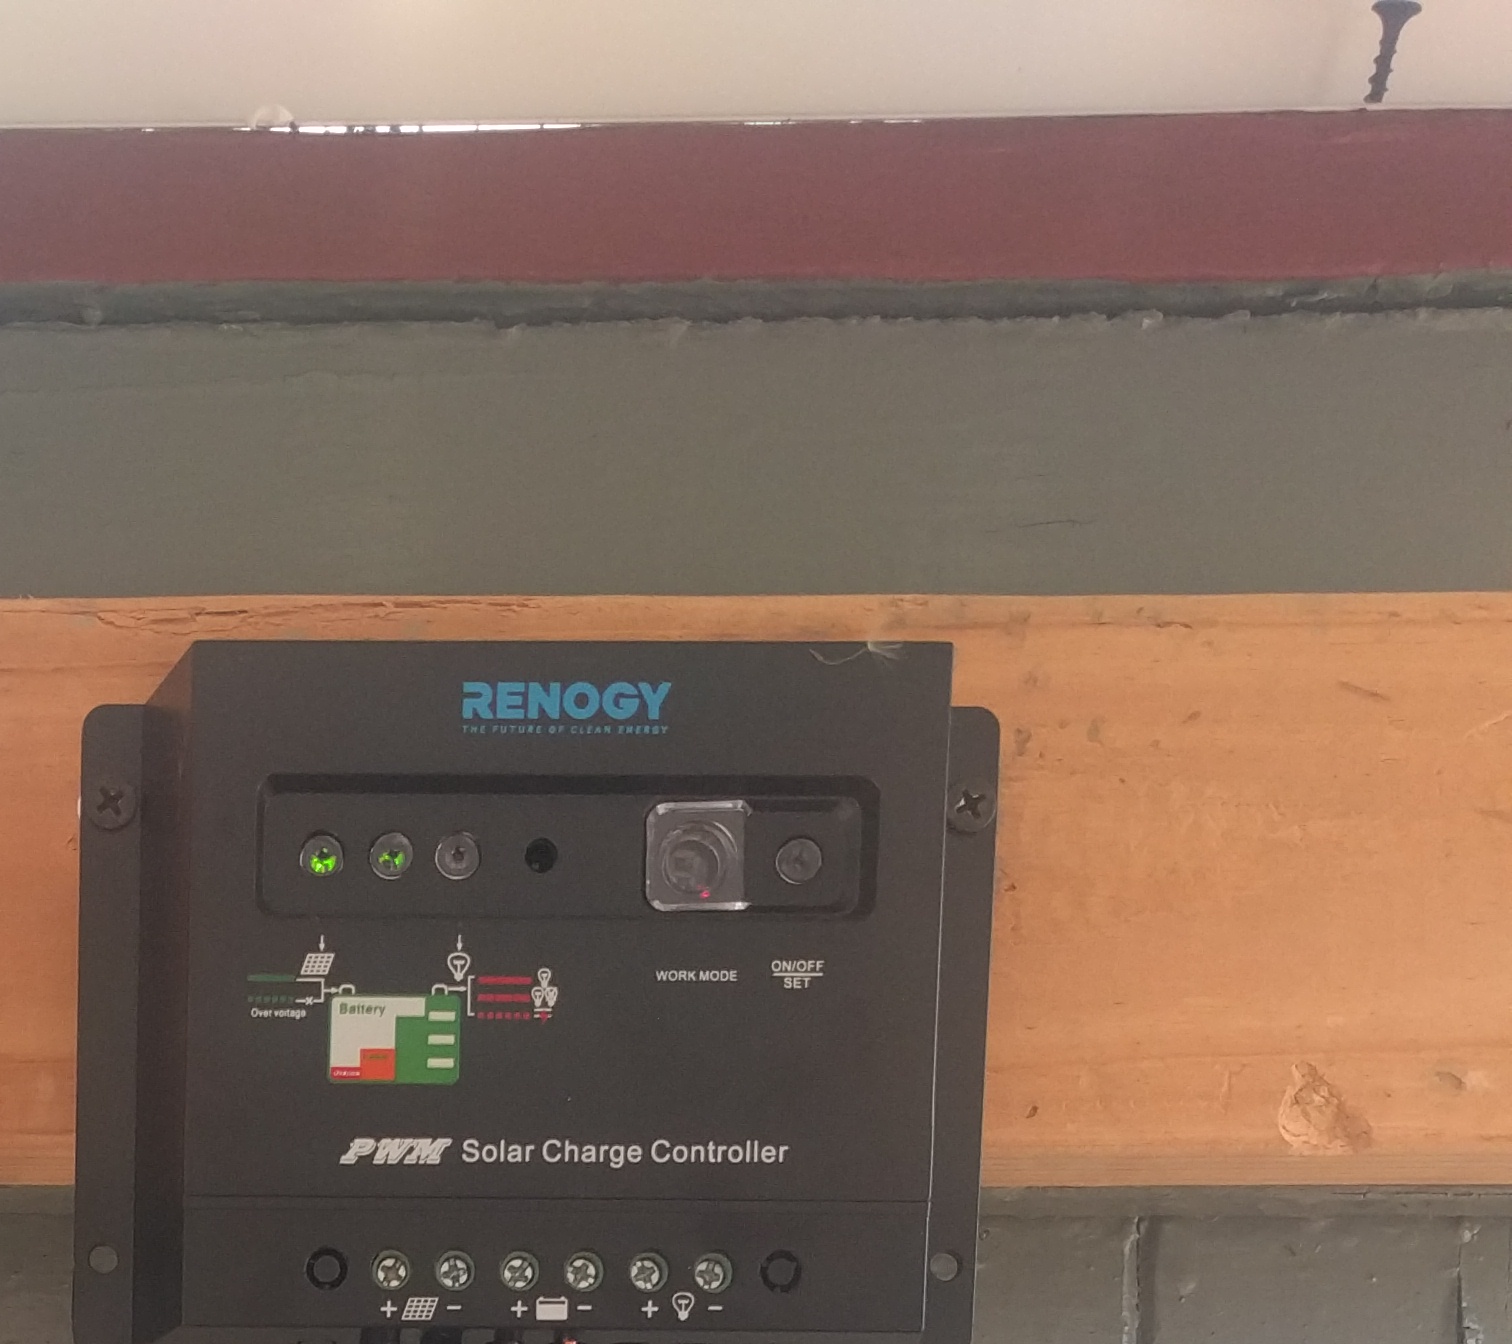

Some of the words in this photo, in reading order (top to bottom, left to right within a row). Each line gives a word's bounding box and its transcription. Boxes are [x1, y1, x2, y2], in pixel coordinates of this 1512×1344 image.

[462, 681, 672, 720] RENOGY
[462, 725, 486, 734] THE
[492, 725, 542, 734] FUTURE
[548, 725, 565, 734] OF
[570, 725, 612, 734] CLEAN
[618, 725, 669, 734] ENERGY
[771, 960, 825, 972] ON/OFF
[656, 970, 697, 981] WORK
[699, 970, 738, 982] MODE
[783, 978, 811, 989] SET
[250, 1008, 272, 1018] Over
[339, 1003, 386, 1017] Battery
[339, 1138, 453, 1165] PWM
[462, 1138, 535, 1163] Solar
[542, 1138, 642, 1168] Charge
[650, 1138, 789, 1164] Controller
